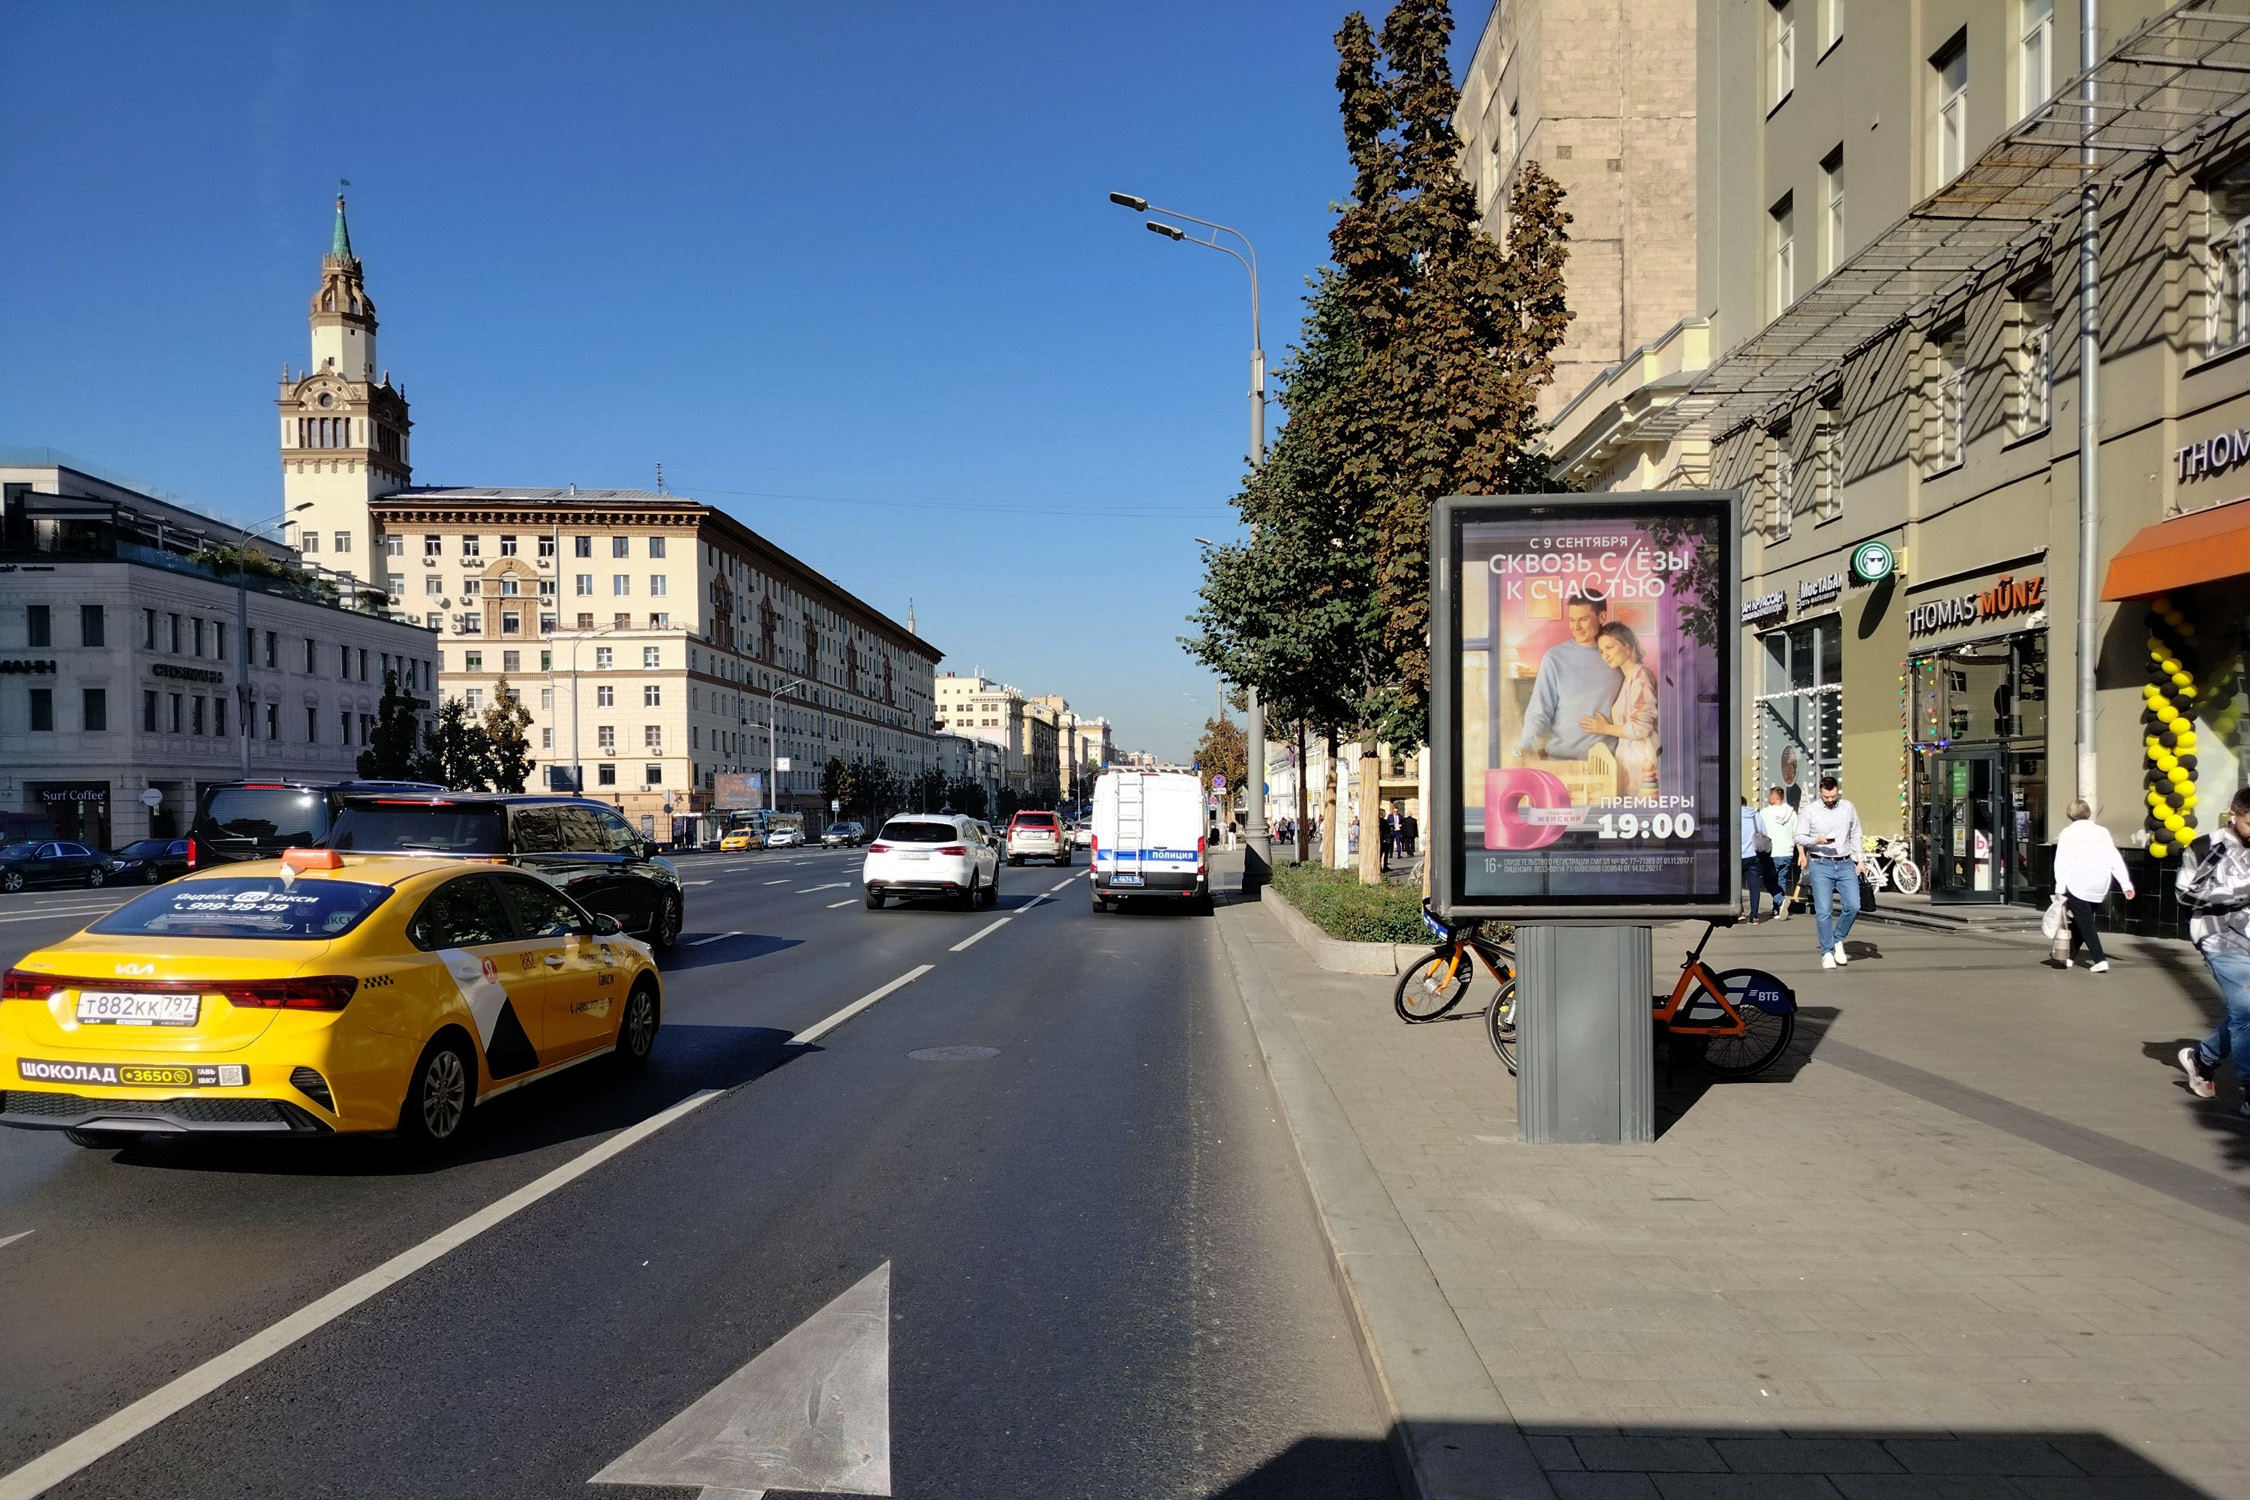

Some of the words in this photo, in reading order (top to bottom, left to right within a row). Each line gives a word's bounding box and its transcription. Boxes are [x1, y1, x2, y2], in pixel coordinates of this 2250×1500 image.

[1529, 538, 1539, 549] С
[1544, 538, 1552, 549] 9
[1556, 536, 1628, 548] СЕНТЯБРЯ
[1489, 553, 1593, 574] СКВОЗЬ
[1599, 538, 1689, 581] СЛЁЗЫ
[1507, 580, 1523, 600] К
[1530, 572, 1666, 601] СЧАСТЬЮ
[1905, 594, 1974, 633] THOMAS
[43, 791, 68, 800] Surf
[1600, 795, 1695, 809] ПРЕМЬЕРЫ
[1598, 813, 1695, 839] 19:00
[1152, 851, 1193, 860] ПОЛИЦИЯ
[1484, 858, 1503, 873] 16+
[172, 893, 234, 901] Яндекс
[268, 893, 320, 903] Такси
[187, 902, 289, 911] 999-99-99
[519, 951, 537, 971] 882
[1759, 992, 1779, 1001] ВТБ
[87, 996, 159, 1017] Т882КК
[163, 996, 193, 1012] 797
[20, 1062, 118, 1083] ШОКОЛАД
